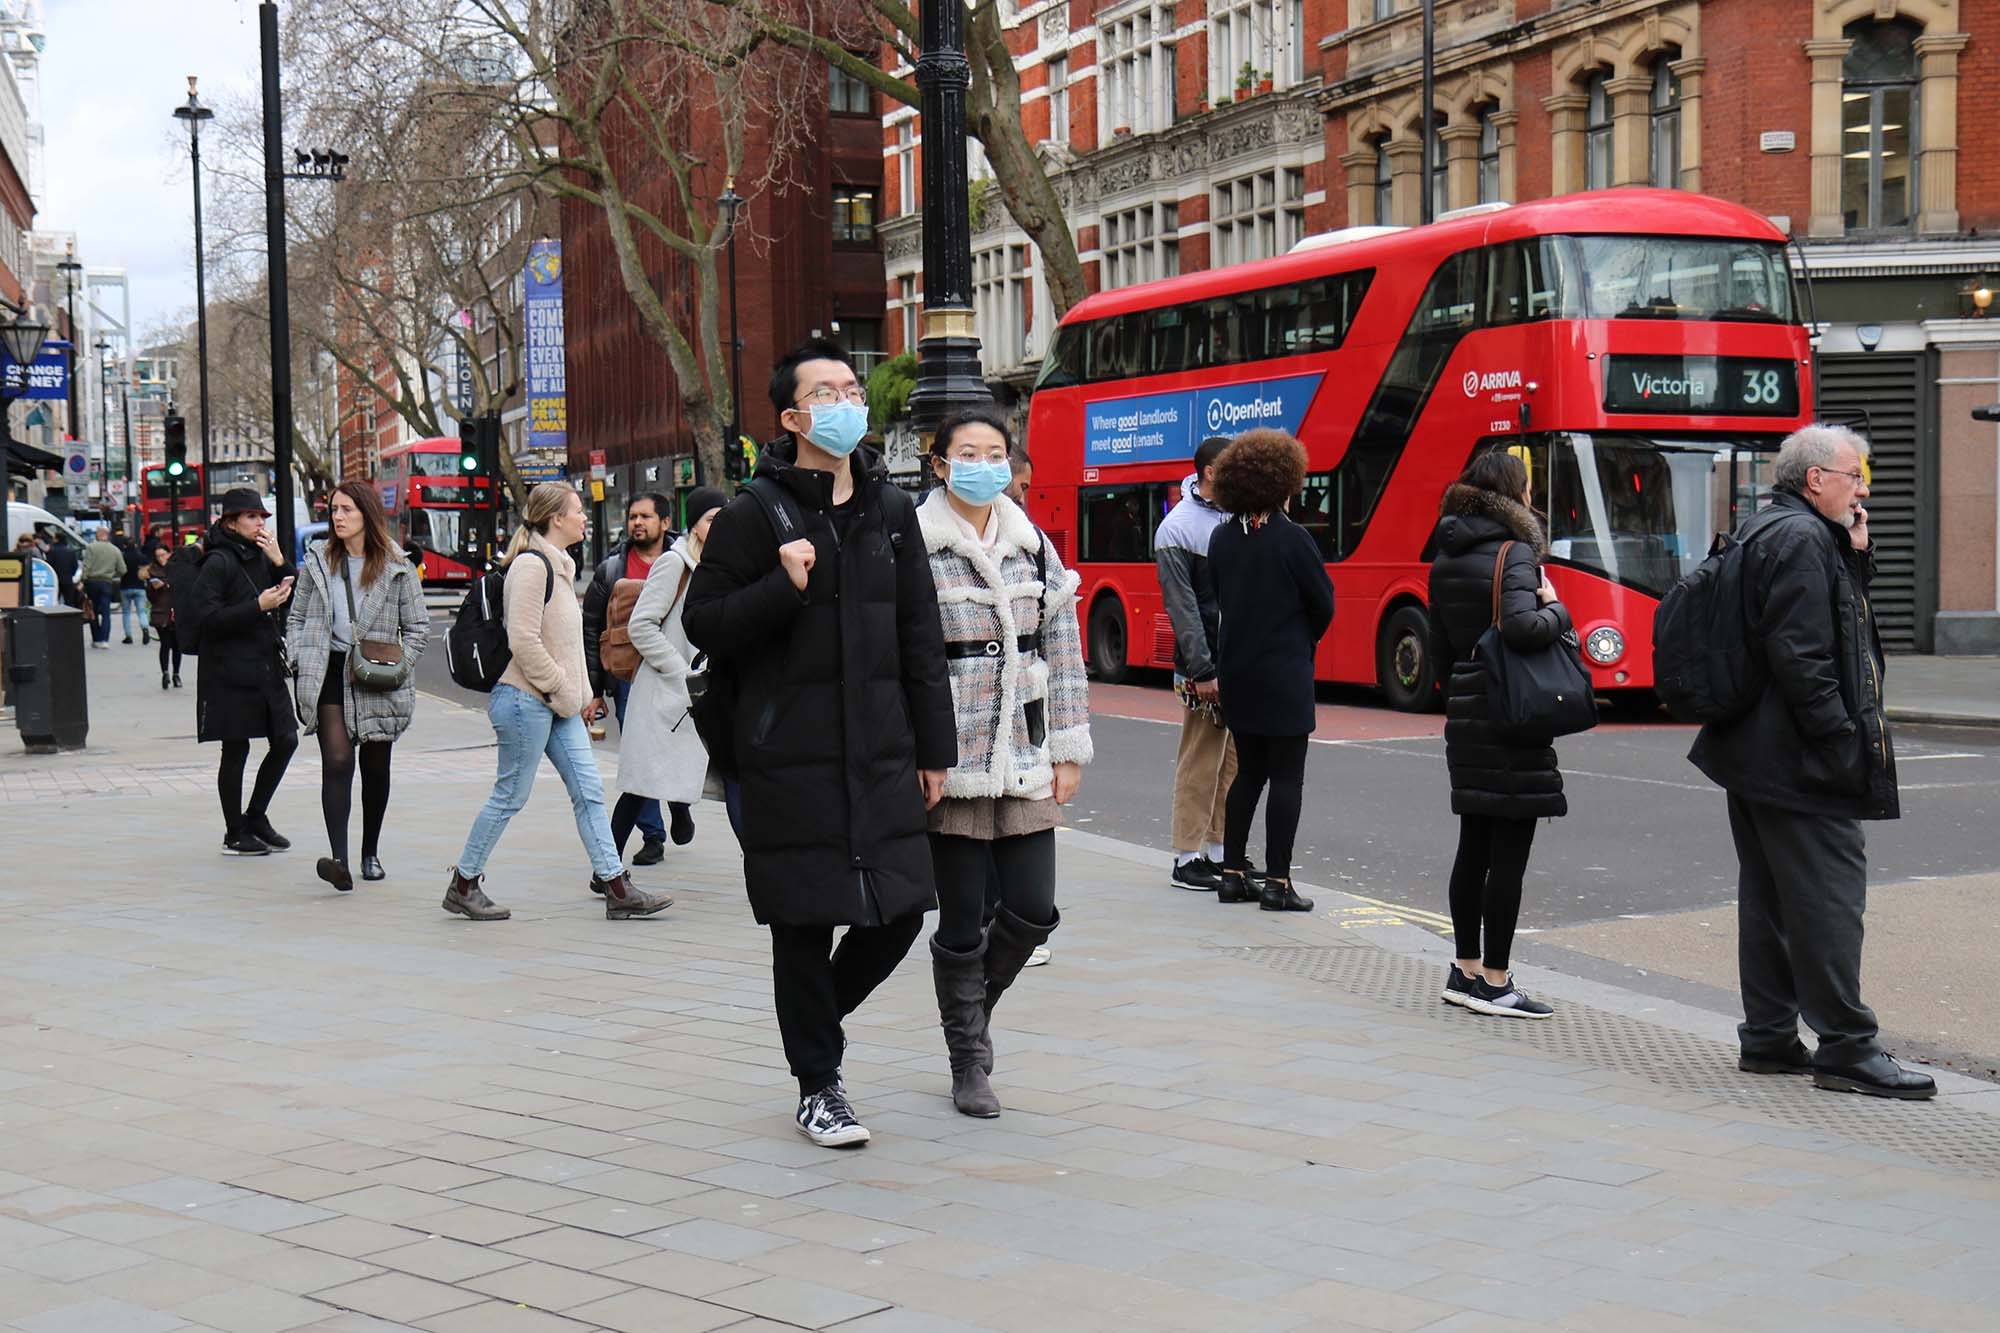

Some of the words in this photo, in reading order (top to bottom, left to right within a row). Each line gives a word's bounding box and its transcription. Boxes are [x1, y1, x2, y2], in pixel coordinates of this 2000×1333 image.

[1479, 370, 1522, 391] ARRIVA
[1632, 372, 1705, 396] Victoria
[1743, 369, 1780, 404] 38
[1091, 415, 1117, 430] Where
[1118, 411, 1138, 432] good
[1139, 407, 1179, 425] landlords
[1224, 396, 1282, 426] OpenRent
[1091, 435, 1111, 452] meet
[1112, 433, 1132, 453] good
[1133, 431, 1164, 448] tenants
